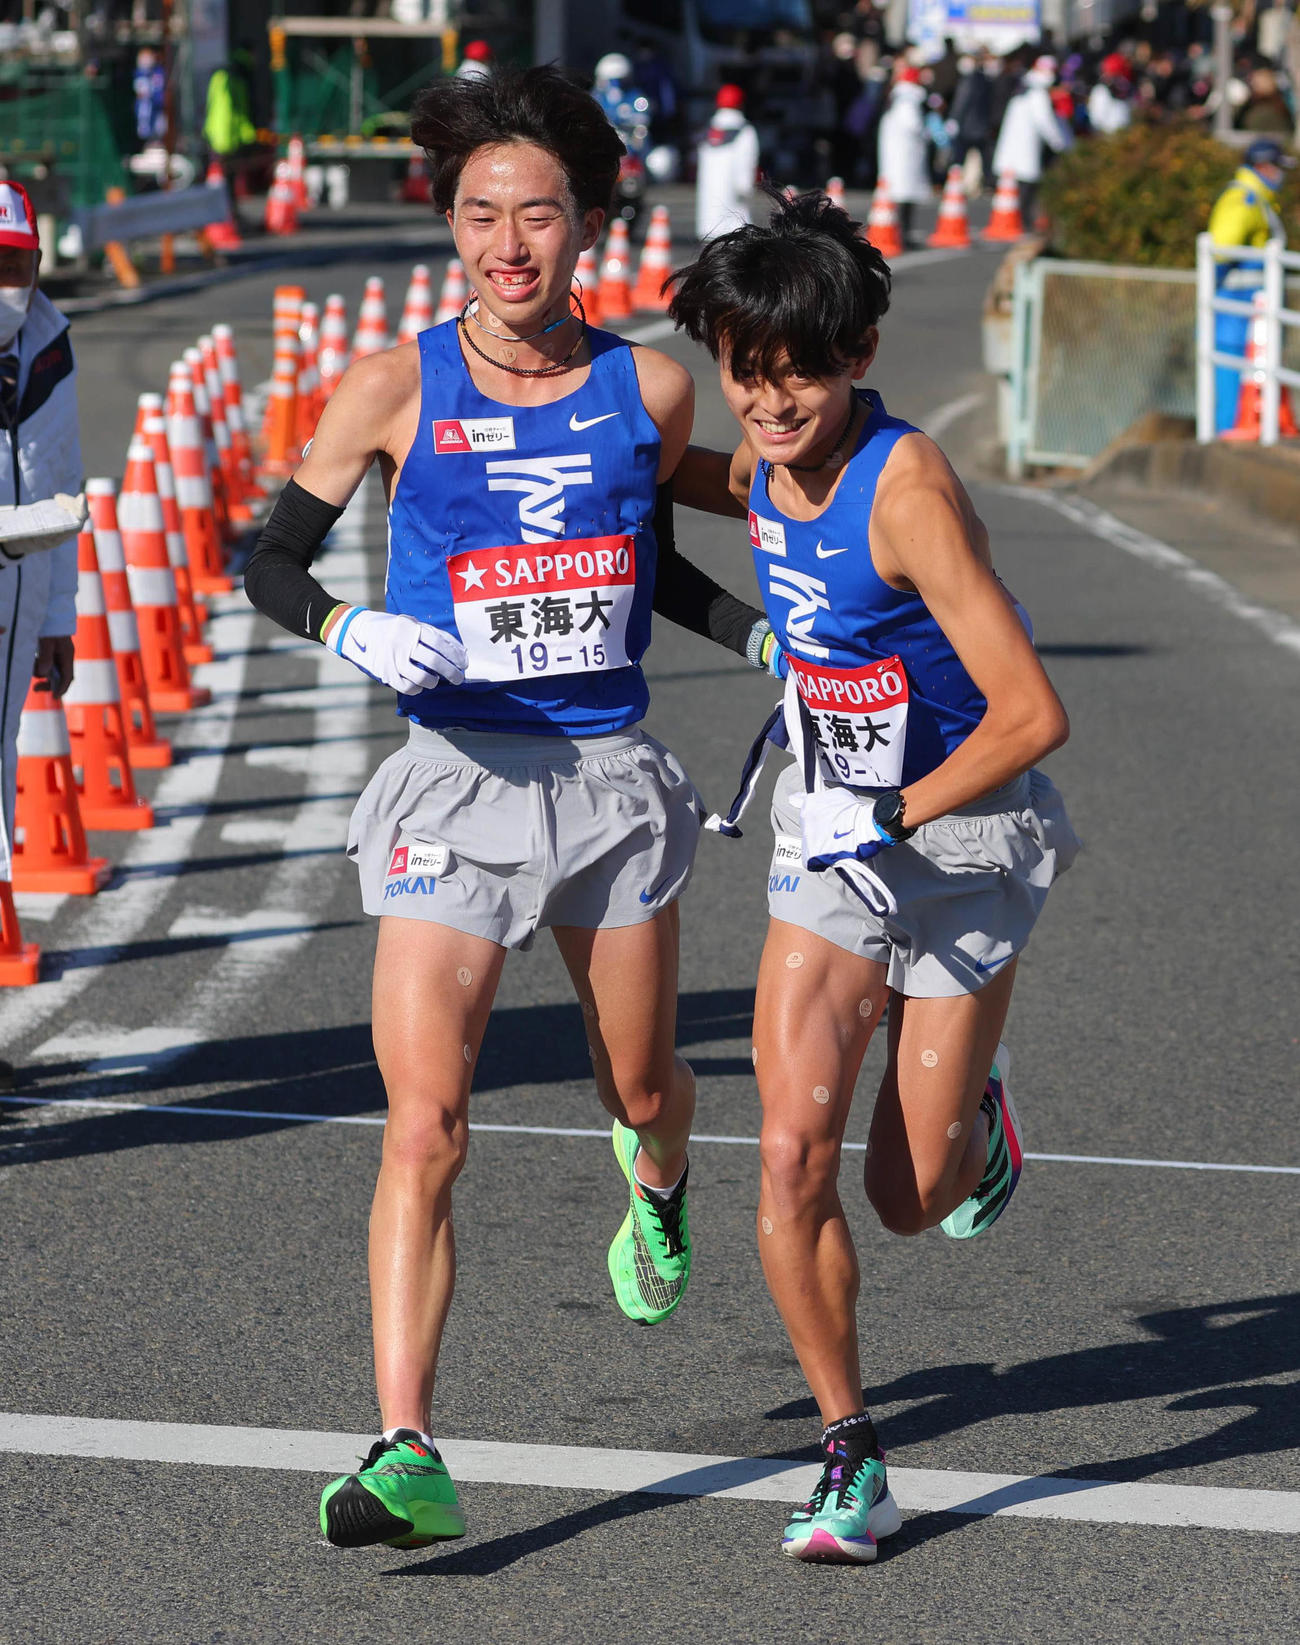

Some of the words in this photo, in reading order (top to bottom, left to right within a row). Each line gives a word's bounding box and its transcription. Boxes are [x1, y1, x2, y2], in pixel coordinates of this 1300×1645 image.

[472, 429, 510, 442] inゼリー
[495, 548, 629, 587] SAPPORO
[485, 590, 614, 643] 東海大
[511, 641, 606, 674] 19-15
[798, 671, 903, 704] SAPPORO
[776, 844, 801, 859] inゼリ
[384, 877, 435, 900] TOKAI
